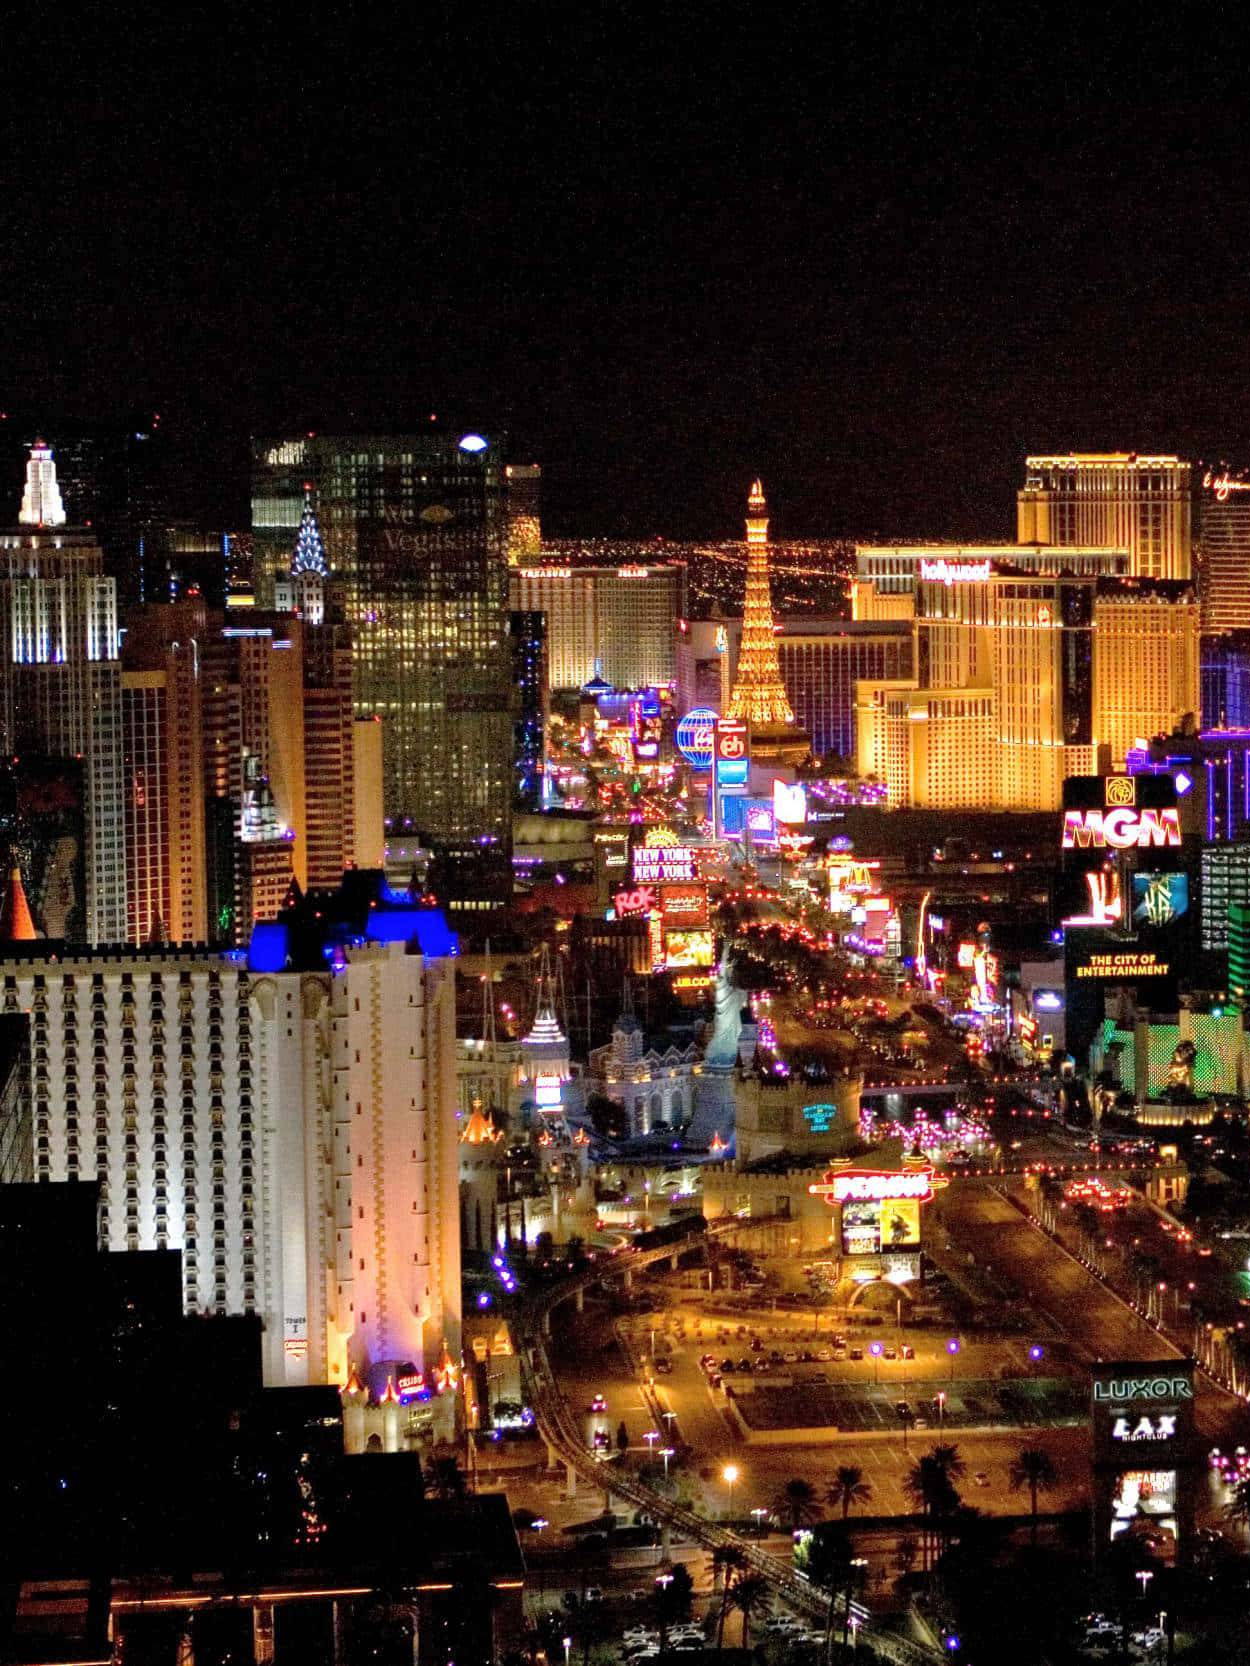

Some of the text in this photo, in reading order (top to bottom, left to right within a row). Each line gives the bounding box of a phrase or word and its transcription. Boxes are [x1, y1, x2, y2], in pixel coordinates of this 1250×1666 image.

[920, 558, 991, 587] hollywood
[1061, 807, 1182, 849] MGM
[634, 848, 660, 862] NEW
[663, 848, 693, 862] YORK
[634, 864, 693, 879] NEW YORK
[1090, 954, 1156, 966] THE CITY OF
[1077, 964, 1169, 977] ENTERTAINMENT
[1094, 1378, 1193, 1400] LUXOR
[1113, 1416, 1177, 1438] LAX
[1122, 1432, 1168, 1441] NIGHTCLUB
